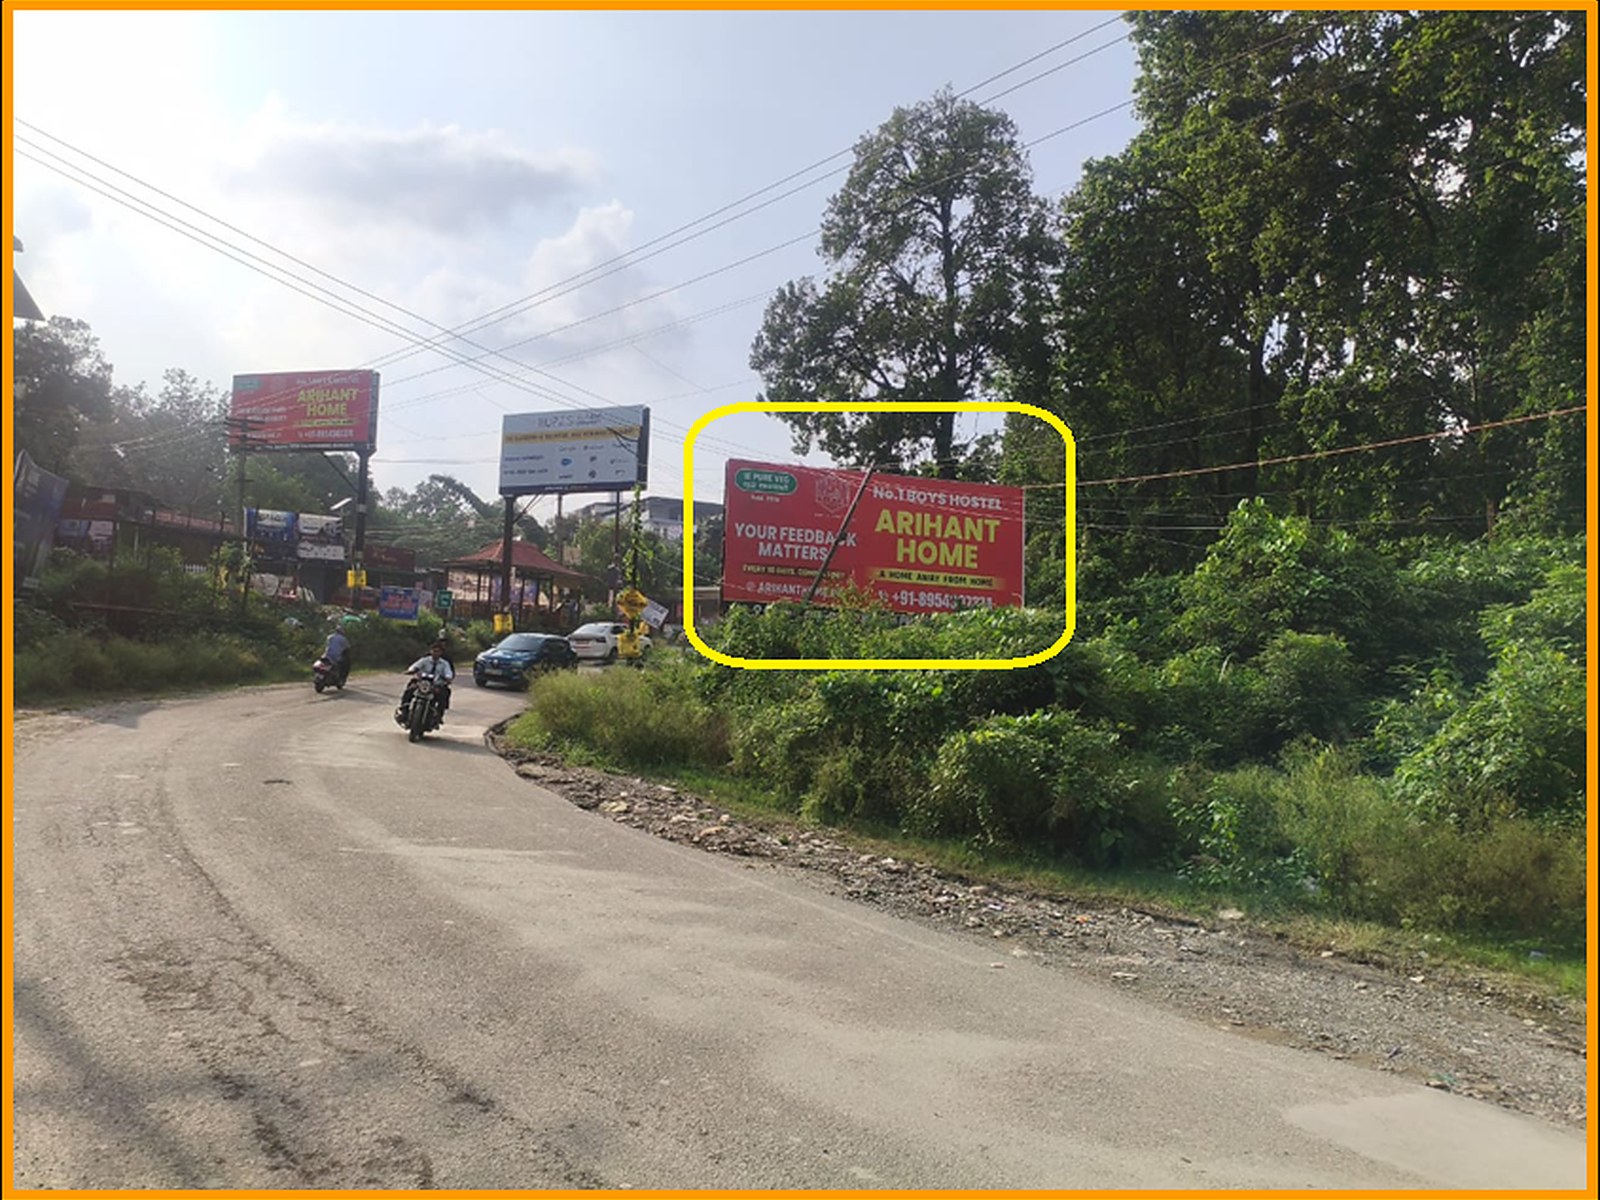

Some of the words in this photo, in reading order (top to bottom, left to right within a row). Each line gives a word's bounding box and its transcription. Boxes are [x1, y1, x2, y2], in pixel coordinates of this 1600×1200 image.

[297, 388, 357, 402] ARIHANT
[307, 403, 347, 416] HOME
[906, 489, 947, 505] BOYS
[949, 493, 1003, 511] HOSTEL
[734, 522, 776, 540] YOUR
[874, 508, 1001, 543] ARIHANT
[758, 541, 828, 561] MATTERS
[896, 536, 979, 569] HOME
[742, 563, 766, 573] EVERY
[879, 570, 886, 578] A
[889, 571, 913, 581] HOME
[915, 573, 941, 583] AWAY
[943, 576, 968, 585] FROM
[970, 579, 994, 588] HOME
